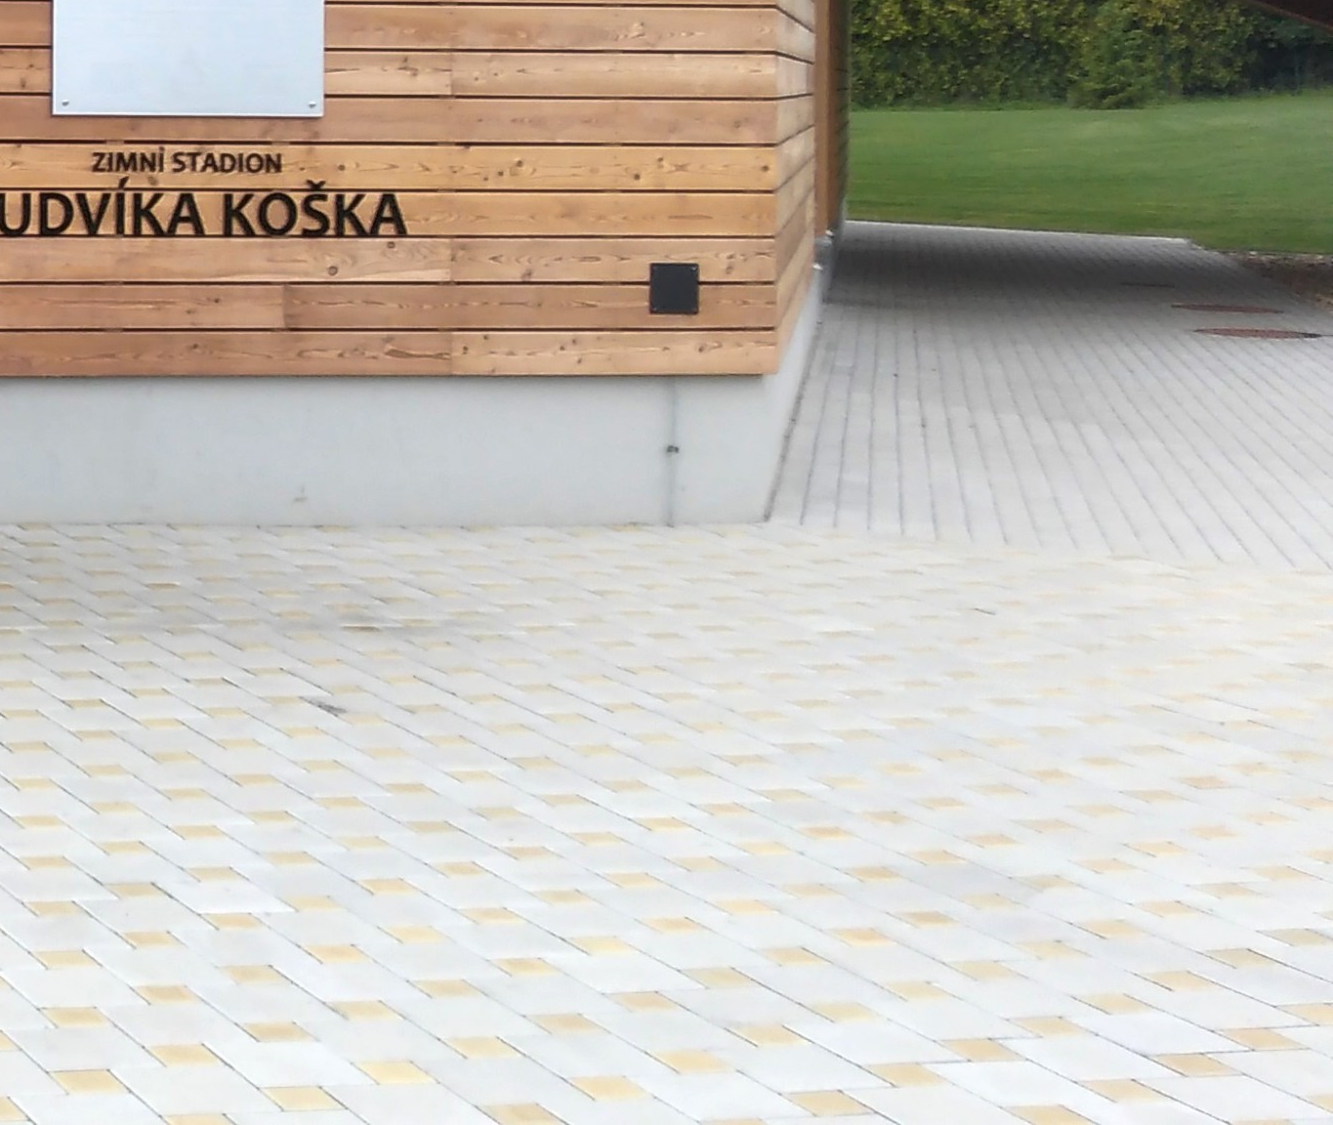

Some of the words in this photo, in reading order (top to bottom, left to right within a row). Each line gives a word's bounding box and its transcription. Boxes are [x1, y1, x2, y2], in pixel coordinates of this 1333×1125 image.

[91, 146, 165, 173] ZIMNÍ
[172, 151, 282, 173] STADION
[223, 179, 408, 237] KOŠKA
